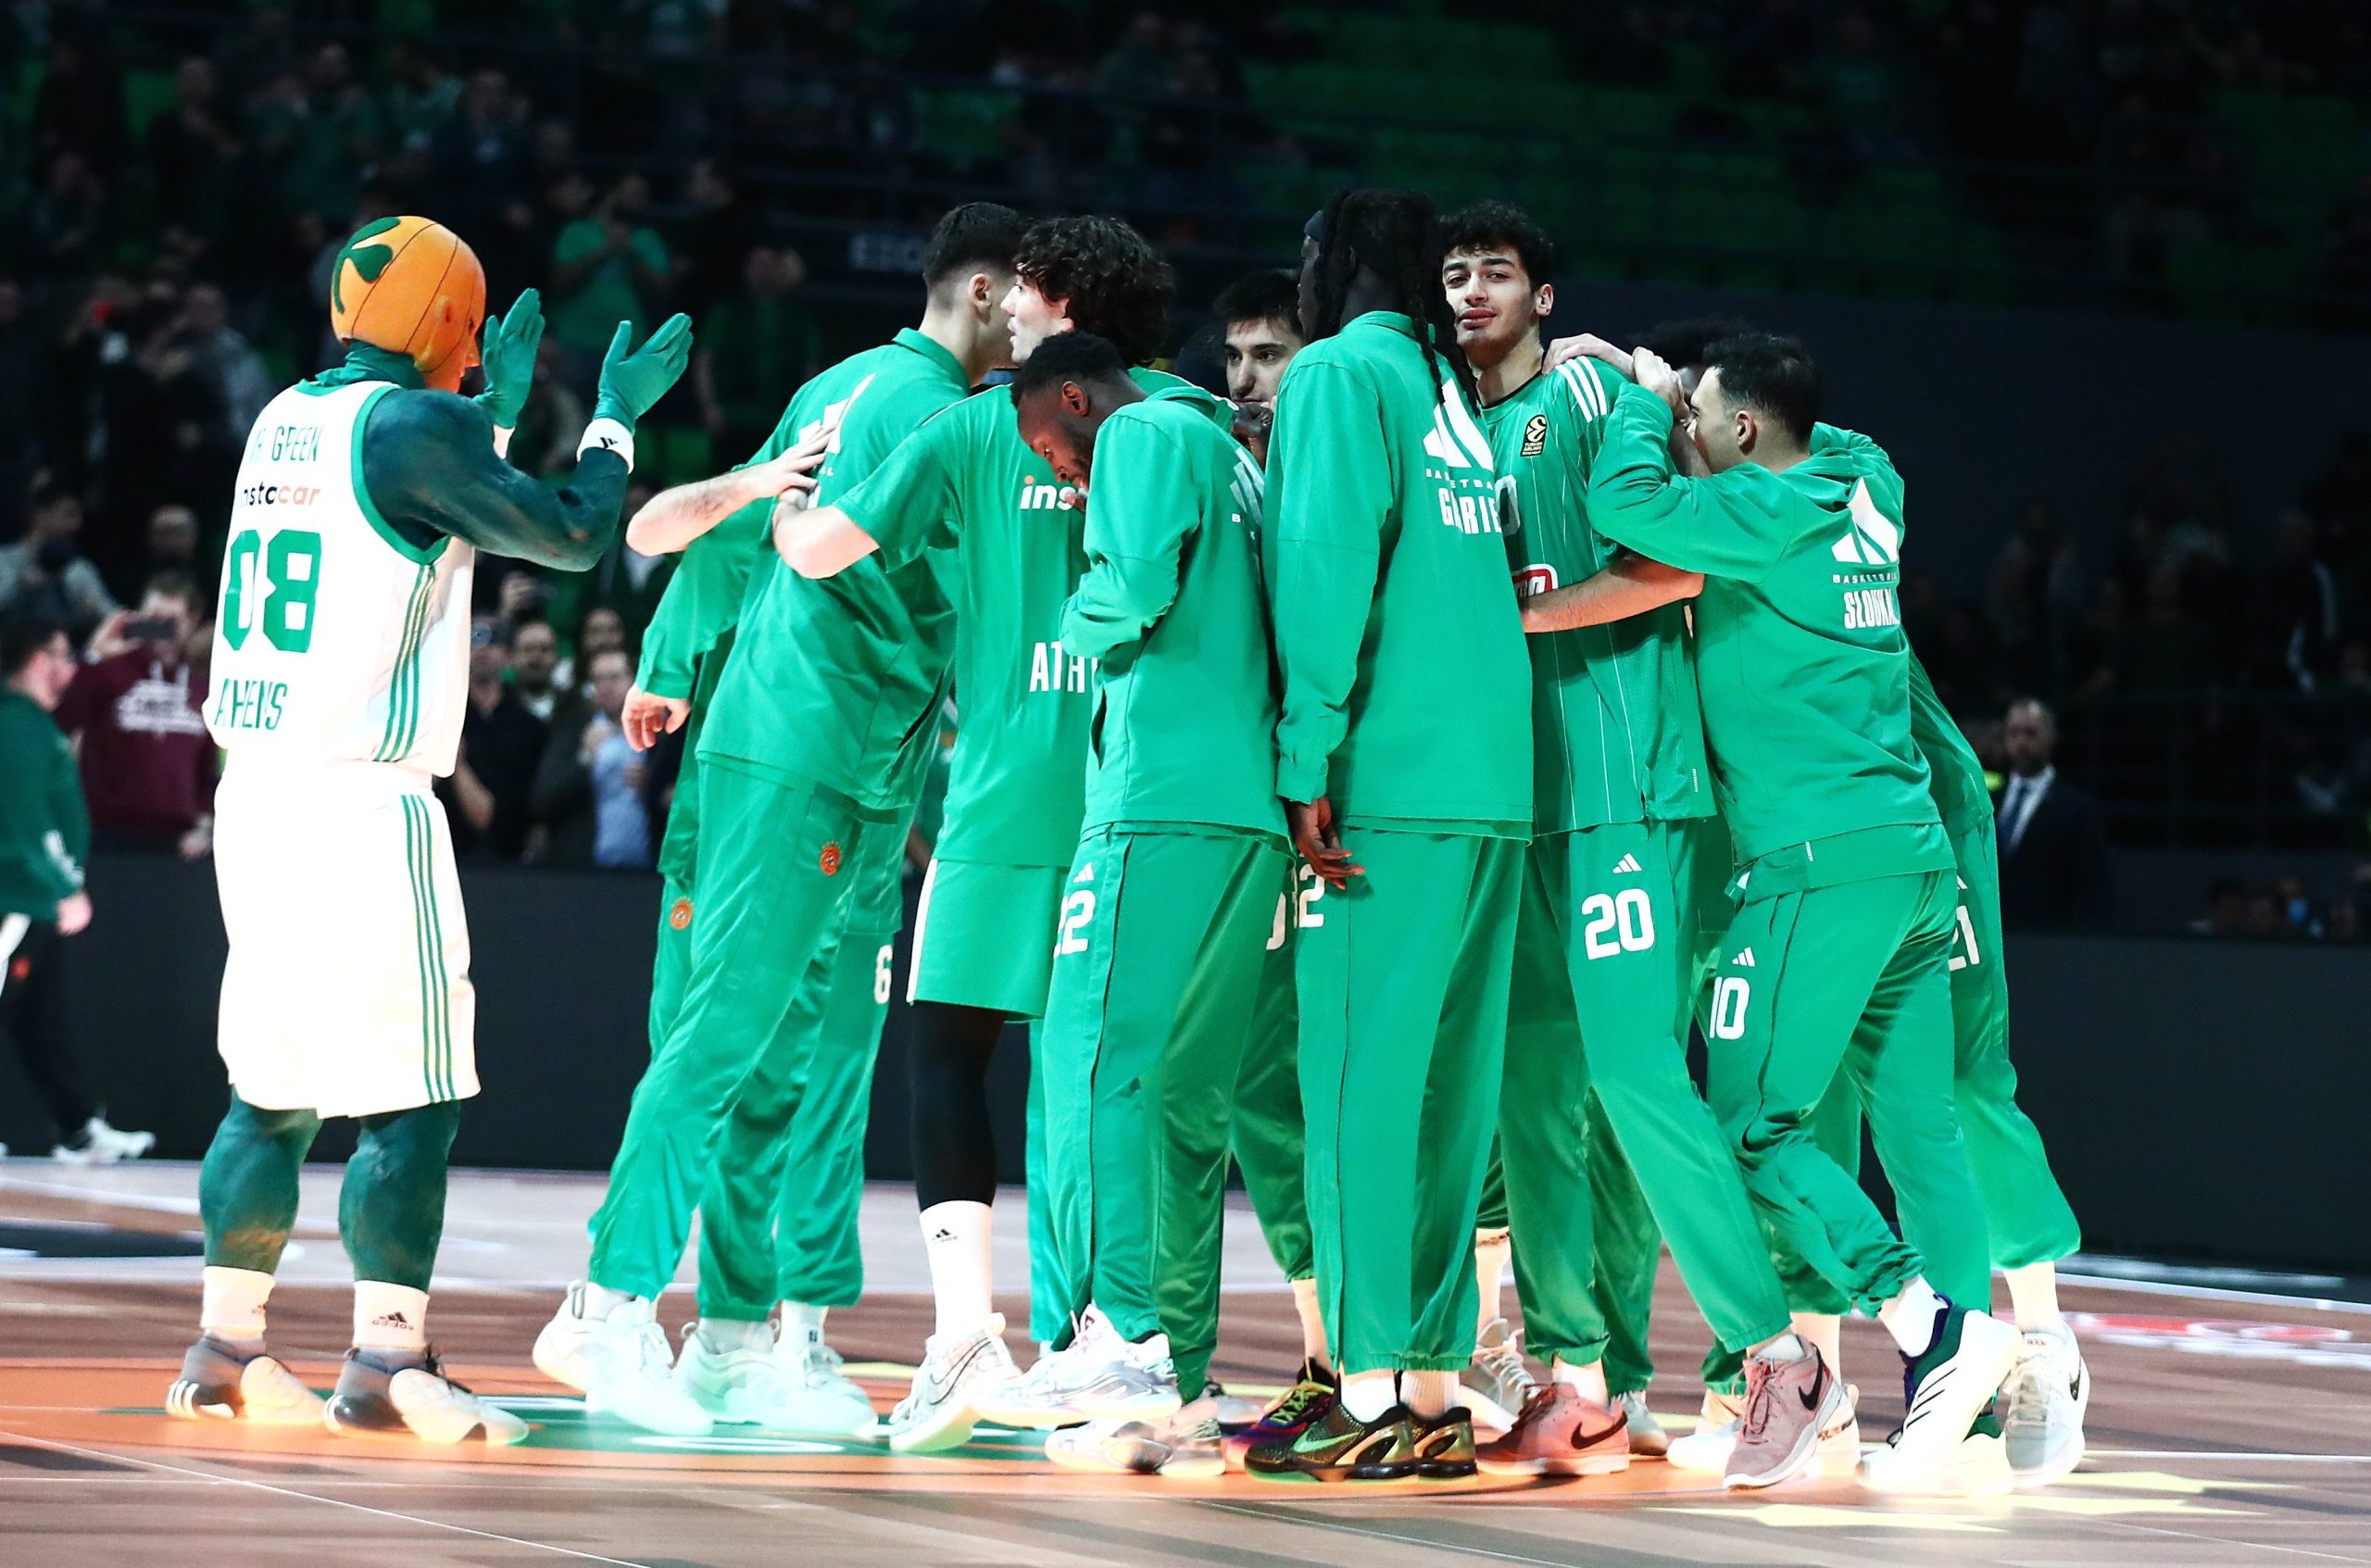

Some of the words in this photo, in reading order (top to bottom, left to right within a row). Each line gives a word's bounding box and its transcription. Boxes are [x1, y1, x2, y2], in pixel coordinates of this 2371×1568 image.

[241, 481, 320, 506] nstacar
[222, 529, 322, 653] 08
[1029, 641, 1099, 693] ATH
[1581, 888, 1656, 961] 20
[873, 944, 894, 1005] 6
[1709, 975, 1751, 1041] 10
